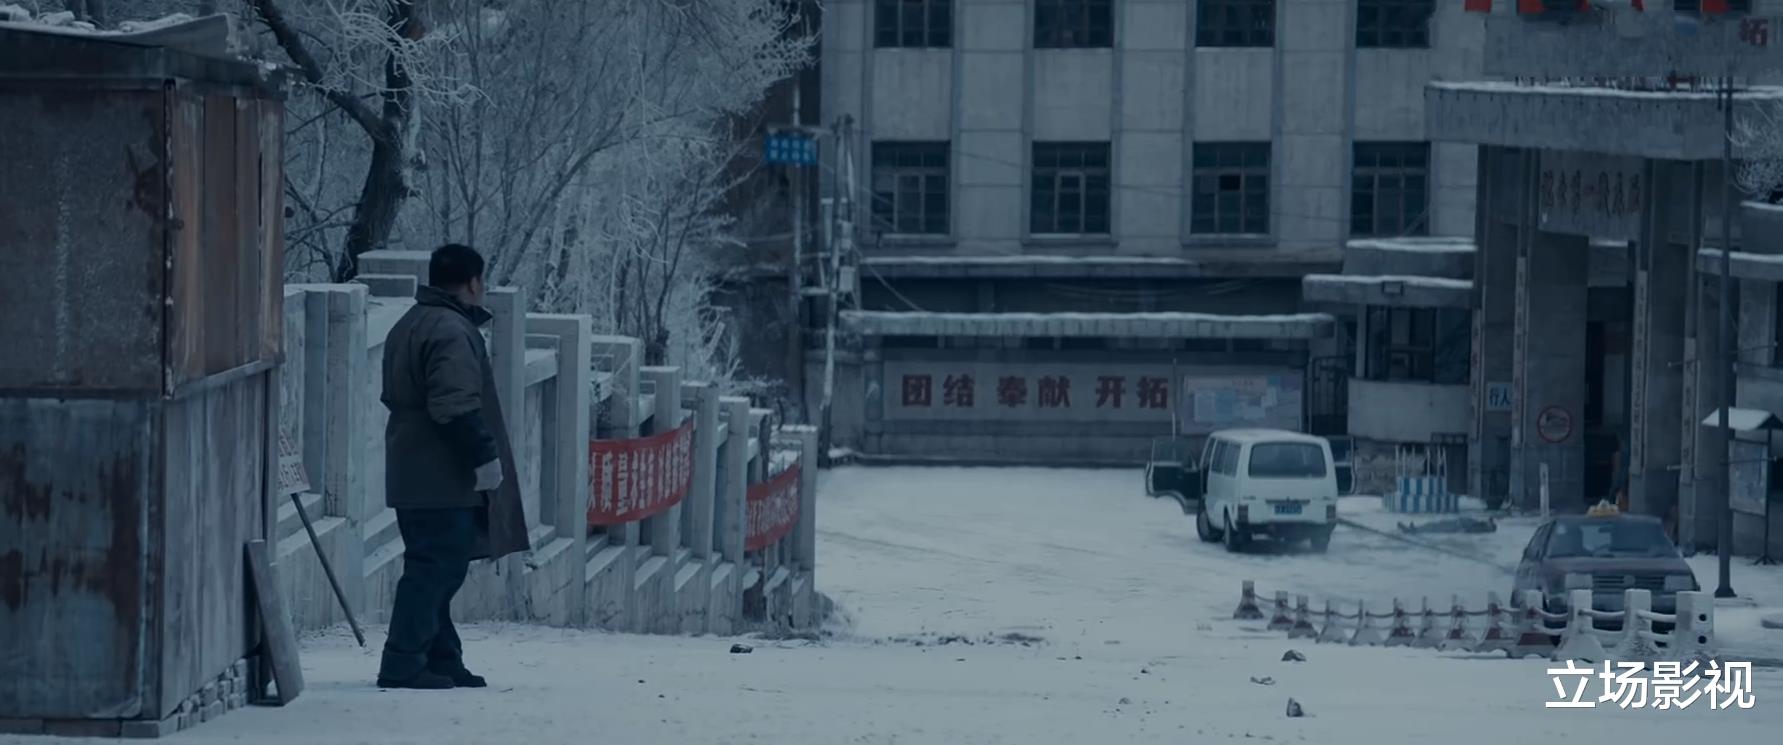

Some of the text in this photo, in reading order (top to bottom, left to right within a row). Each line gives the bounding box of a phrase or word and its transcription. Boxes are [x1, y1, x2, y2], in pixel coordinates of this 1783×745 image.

[902, 375, 1169, 409] 团结 奉献 开拓
